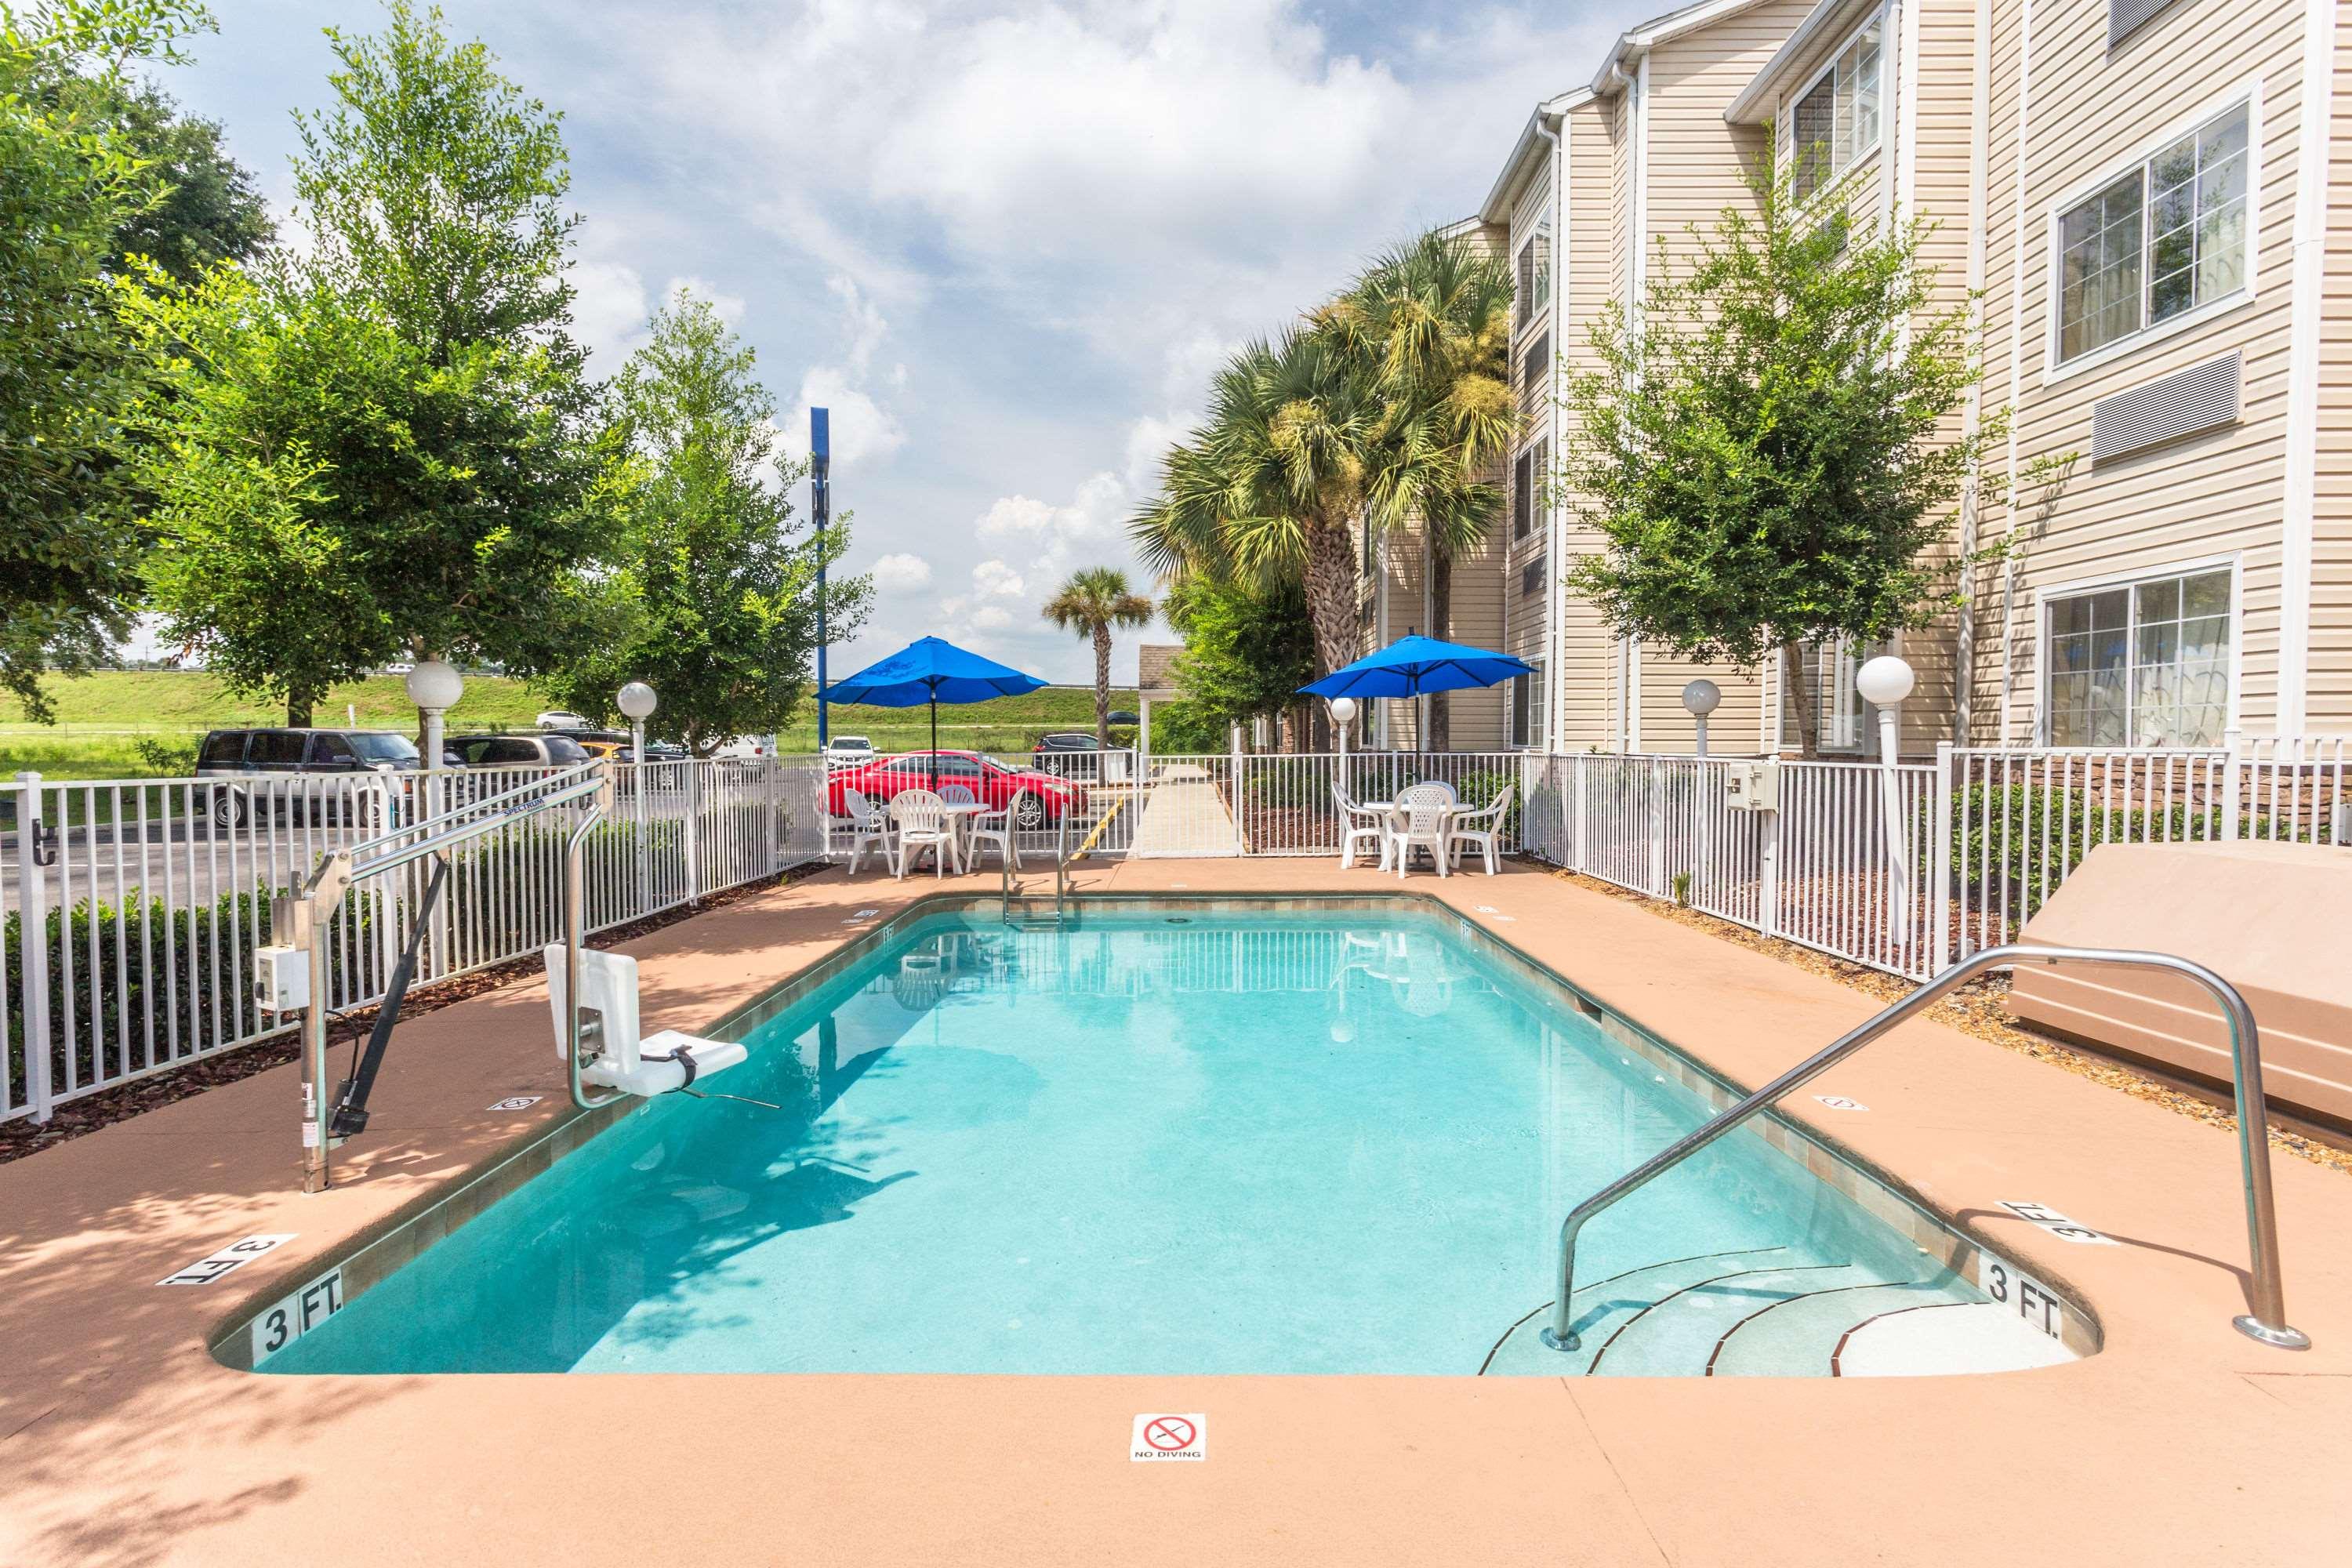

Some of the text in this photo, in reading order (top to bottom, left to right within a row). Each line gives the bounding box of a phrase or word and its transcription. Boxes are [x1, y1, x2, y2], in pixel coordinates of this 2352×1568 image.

[504, 798, 545, 816] SPECTRUM
[2002, 1202, 2096, 1239] 3 FT.
[165, 1240, 275, 1283] 3 FT.
[265, 1272, 342, 1352] 3 FT.
[1989, 1264, 2058, 1340] 3 FT.
